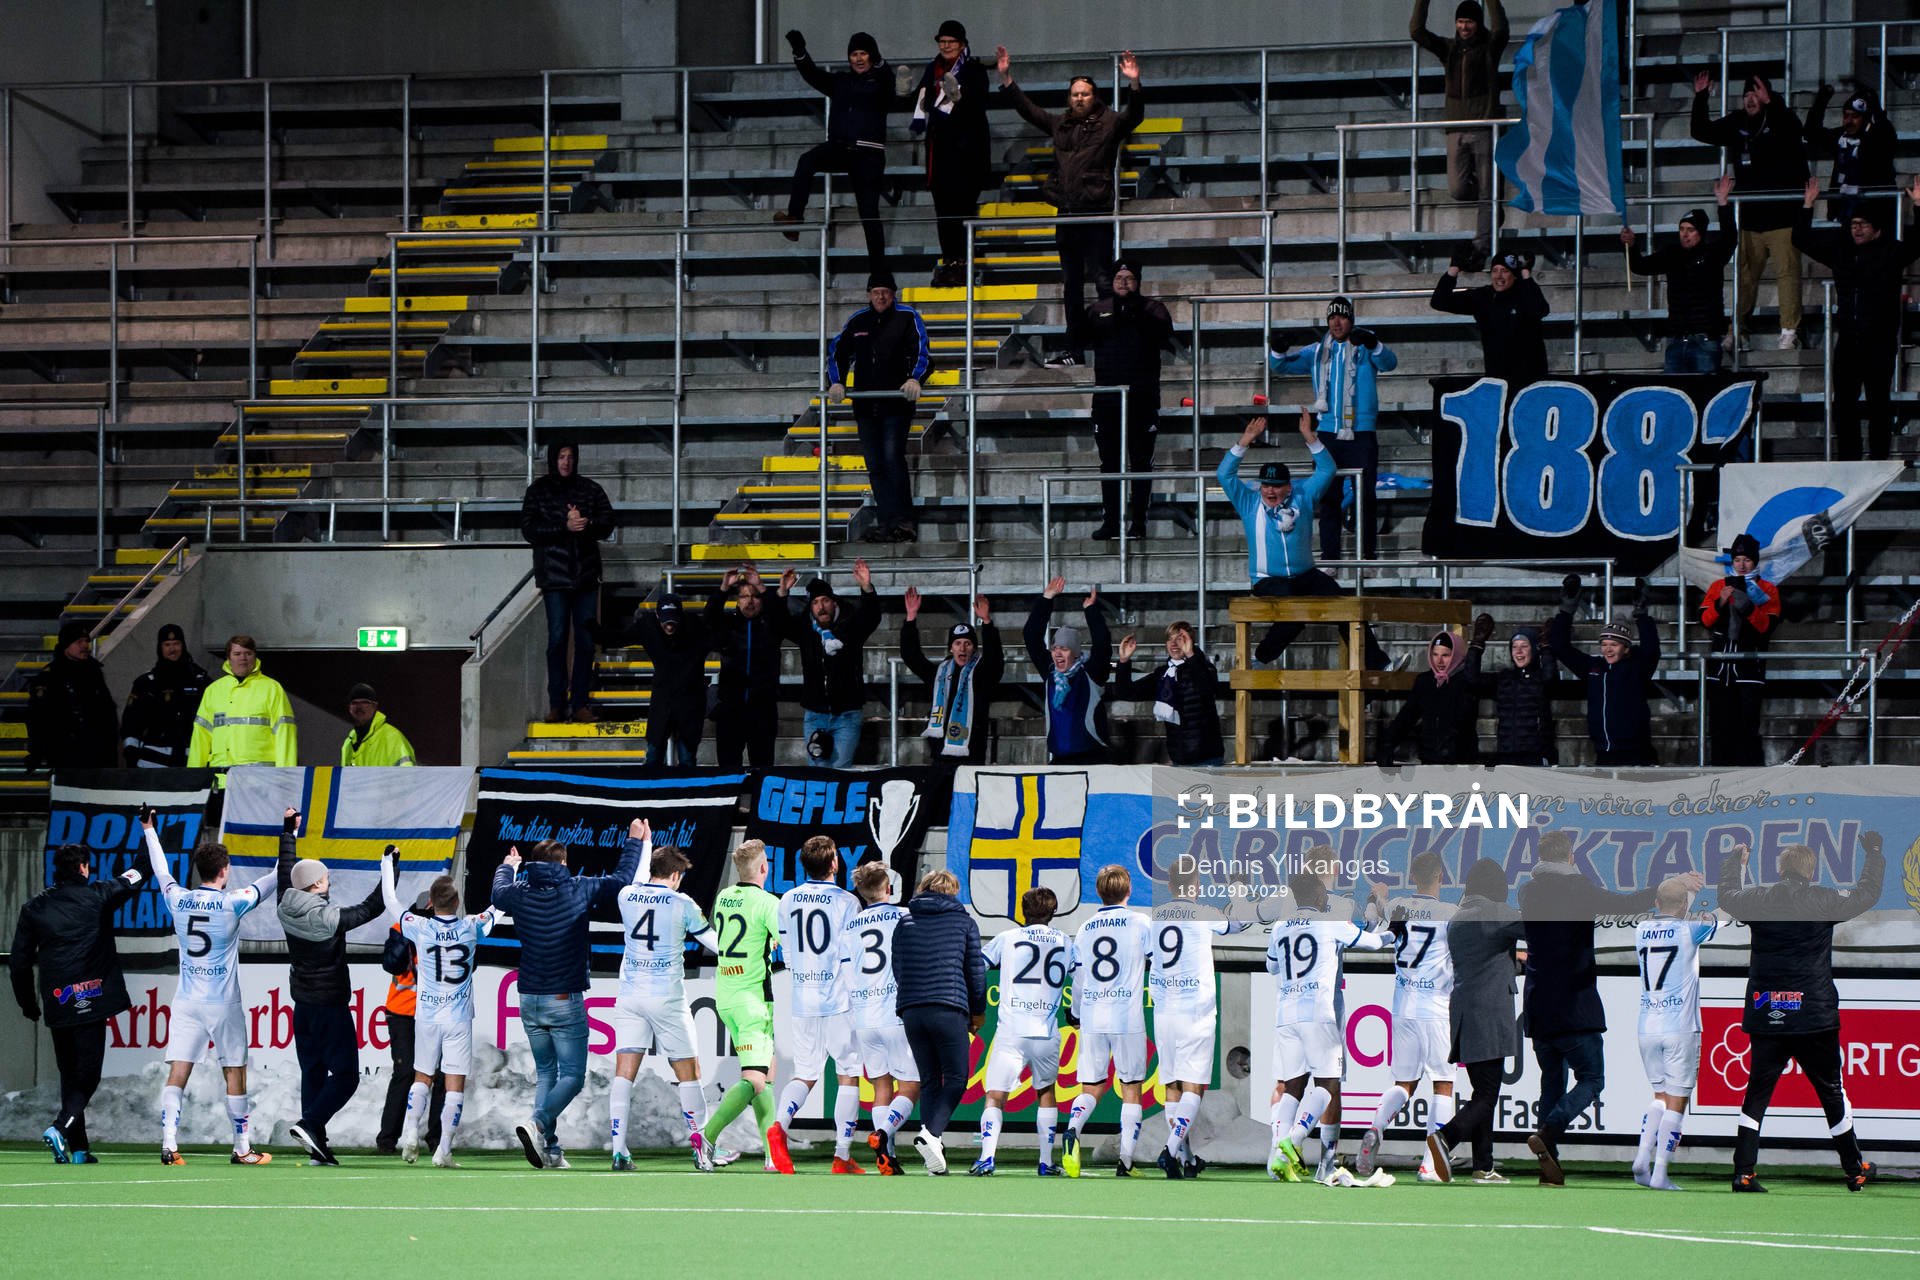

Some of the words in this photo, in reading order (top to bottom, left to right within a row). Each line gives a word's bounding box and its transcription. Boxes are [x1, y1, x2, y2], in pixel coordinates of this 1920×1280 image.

[1441, 377, 1757, 541] 188
[758, 775, 871, 825] GEFLE
[1577, 792, 1654, 817] våra
[178, 898, 223, 911] BJÖRKMAN
[627, 893, 672, 905] ZARKOVIC
[187, 915, 212, 958] 5
[436, 930, 459, 942] KRALJ
[631, 909, 660, 951] 4
[716, 911, 748, 959] 22
[790, 908, 831, 956] 10
[846, 911, 903, 931] LOHIKANGAS
[1642, 928, 1675, 940] LANTTO
[426, 944, 471, 985] 13
[860, 928, 887, 974] 3
[1012, 941, 1066, 989] 26
[1091, 935, 1120, 982] 8
[1159, 925, 1184, 969] 9
[1278, 933, 1318, 980] 19
[792, 968, 834, 983] ngeltofta
[1150, 973, 1200, 989] Engeltofta
[1639, 945, 1679, 992] 17
[1011, 997, 1057, 1011] Engelto
[1771, 991, 1802, 1001] INTER
[1771, 1001, 1802, 1010] SPORT
